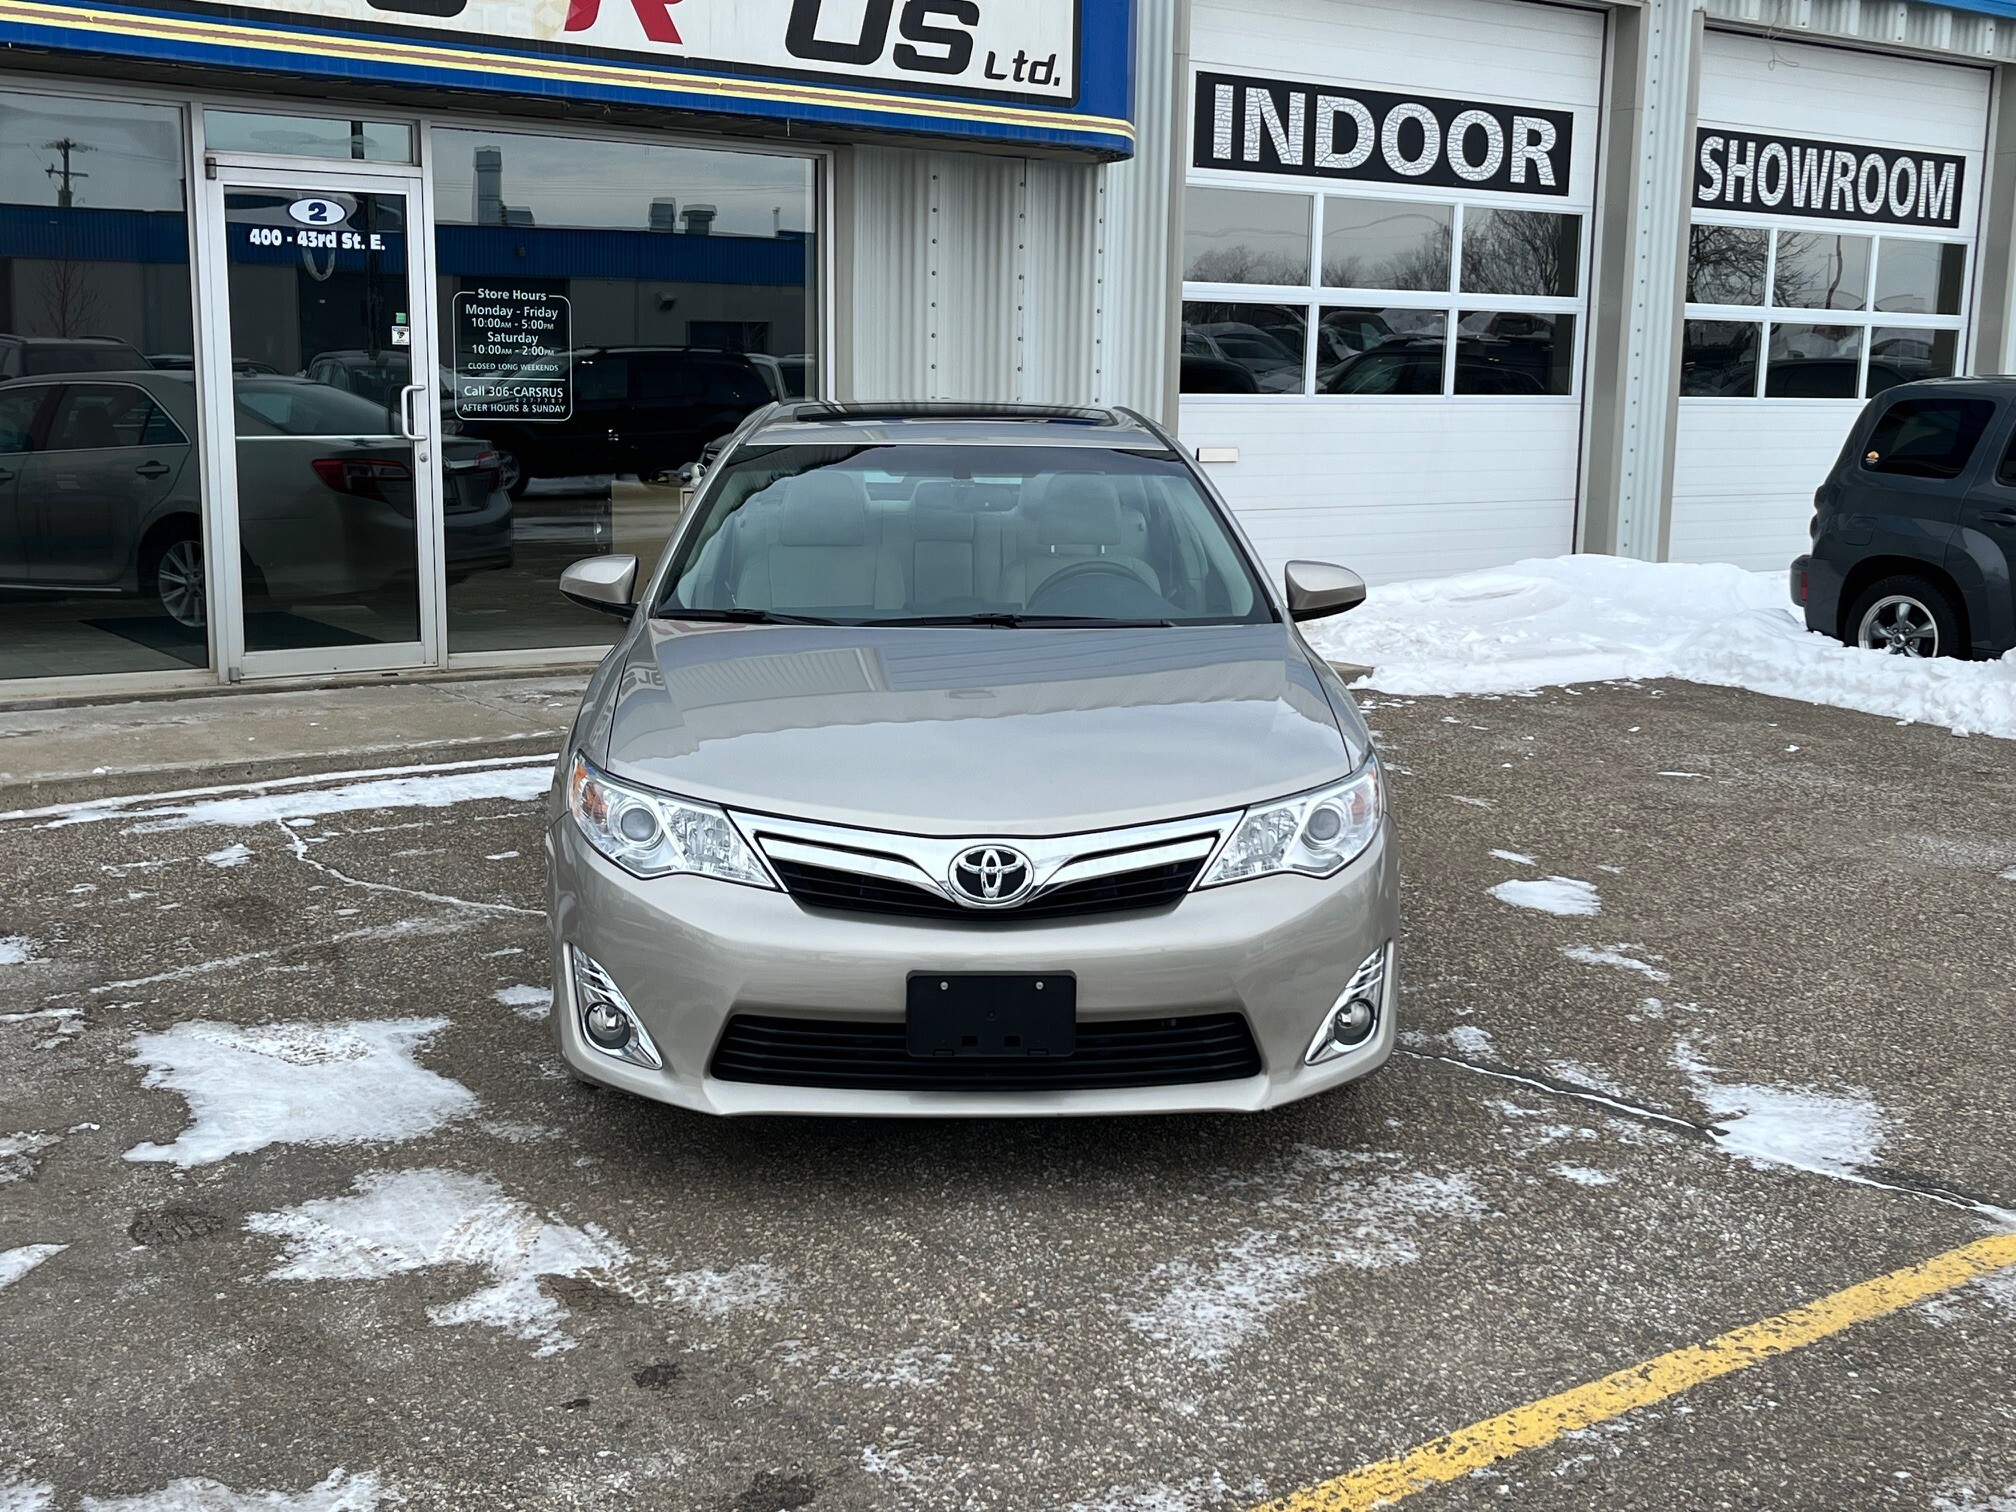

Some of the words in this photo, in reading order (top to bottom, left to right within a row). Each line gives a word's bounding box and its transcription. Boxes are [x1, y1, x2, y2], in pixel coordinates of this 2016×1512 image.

[984, 50, 1061, 87] Ltd.
[1213, 83, 1557, 187] INDOOR
[1698, 135, 1957, 220] SHOWROOM
[308, 202, 328, 222] 2
[249, 228, 282, 246] 400
[297, 230, 337, 248] 43rd
[341, 232, 366, 250] St.
[370, 234, 386, 250] E.
[477, 288, 510, 299] Store
[512, 290, 547, 301] Hours
[465, 304, 514, 319] Monday
[523, 306, 559, 320] Friday
[487, 331, 539, 345] Saturday
[468, 362, 496, 371] CLOSED
[498, 363, 518, 371] LONG
[520, 364, 559, 372] WEEKENDS
[464, 385, 485, 397] Call
[488, 386, 563, 398] 306-CARSRUS
[462, 403, 488, 412] AFTER
[490, 404, 519, 413] HOURS
[522, 404, 529, 413] &
[532, 404, 566, 413] SUNDAY
